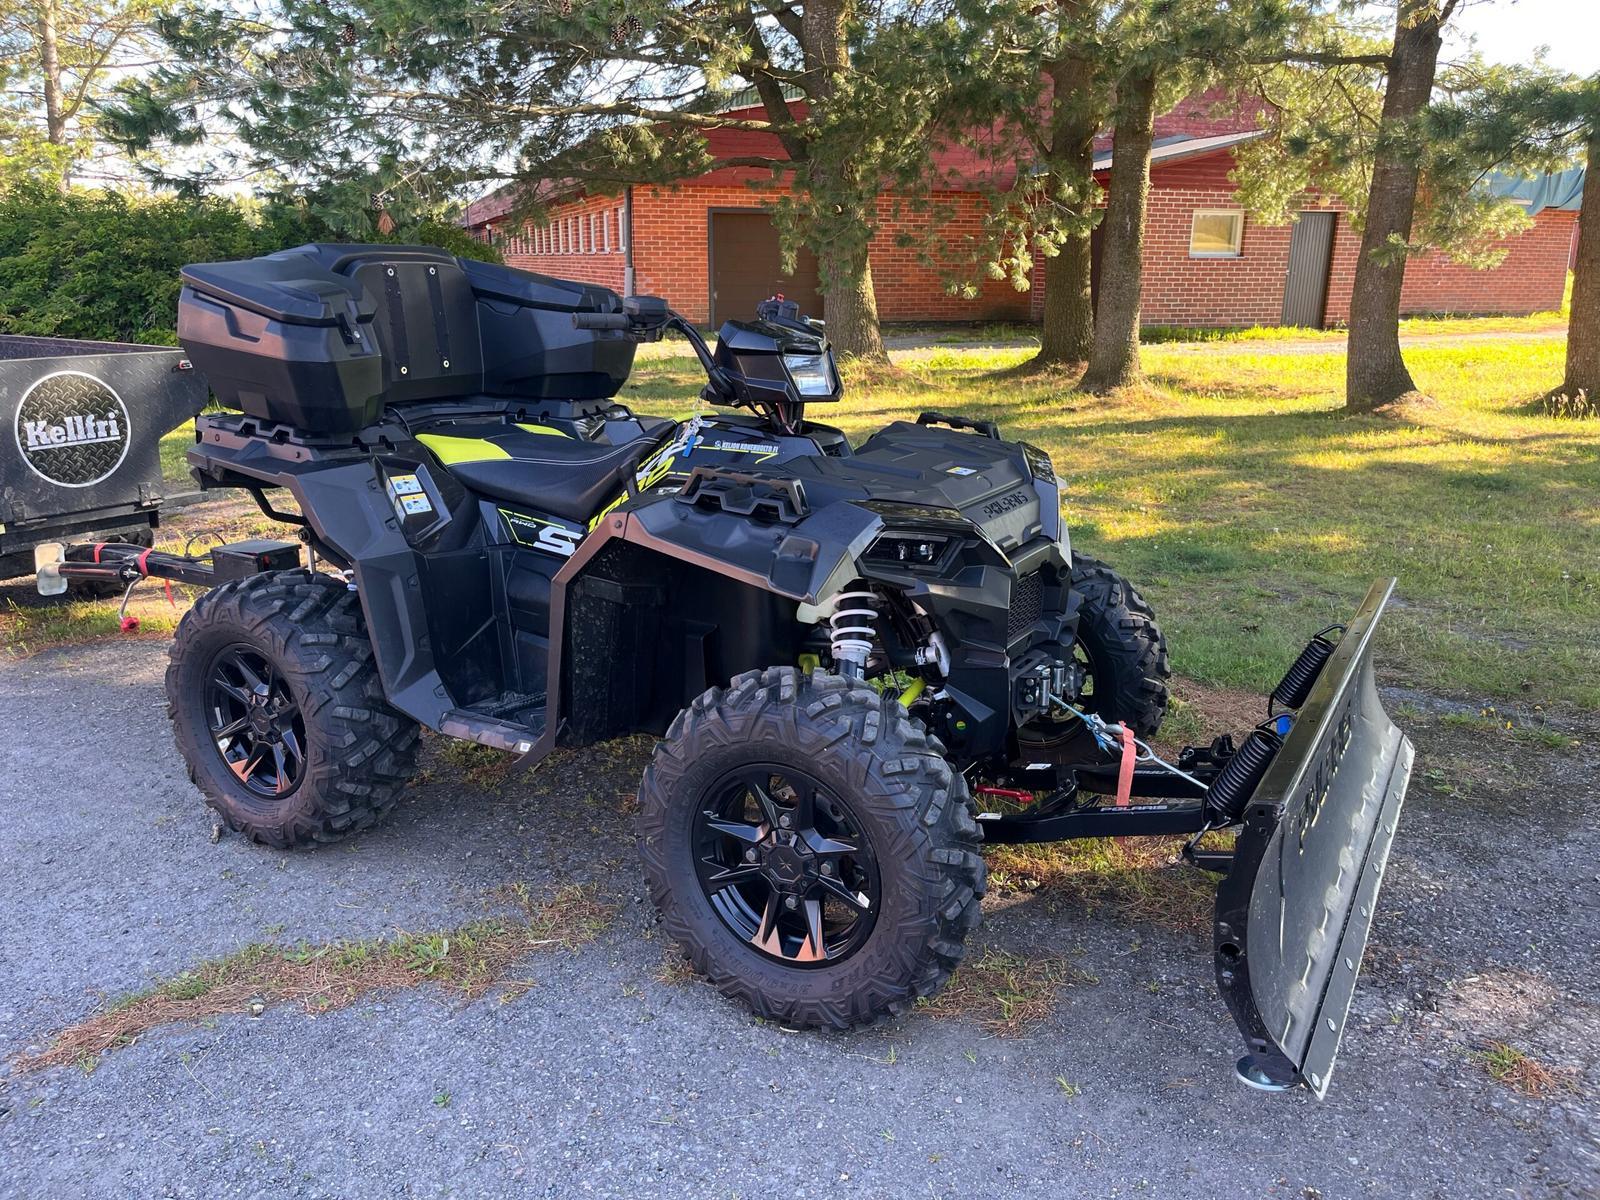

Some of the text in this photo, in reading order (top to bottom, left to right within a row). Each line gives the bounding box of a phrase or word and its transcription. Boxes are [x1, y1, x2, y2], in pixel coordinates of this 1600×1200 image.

[24, 412, 120, 447] Kellfri
[983, 491, 1029, 519] POLARIS
[533, 526, 584, 557] S
